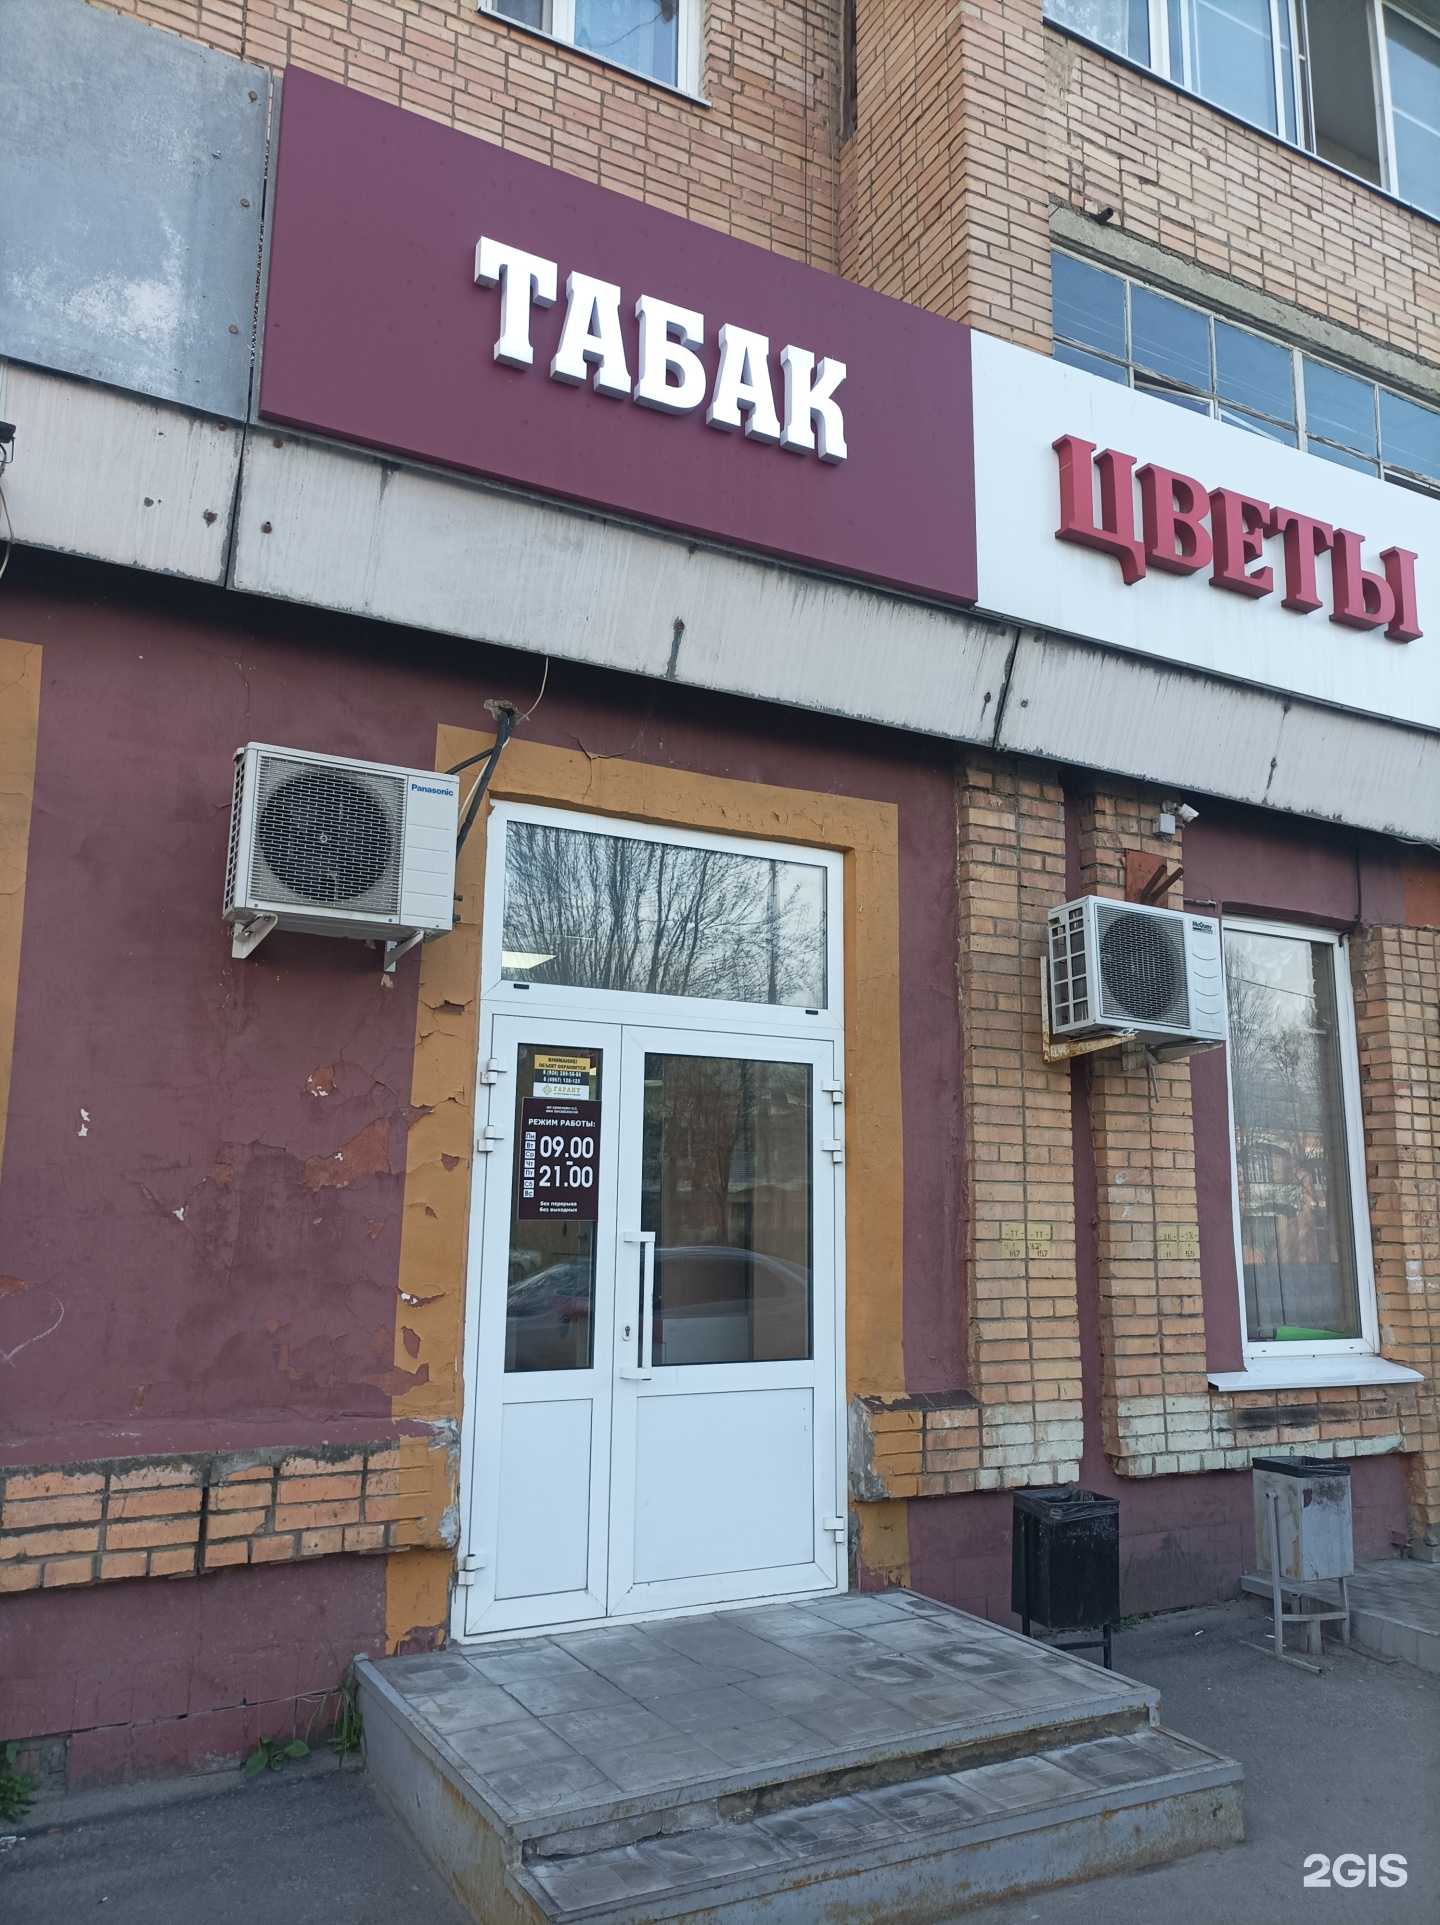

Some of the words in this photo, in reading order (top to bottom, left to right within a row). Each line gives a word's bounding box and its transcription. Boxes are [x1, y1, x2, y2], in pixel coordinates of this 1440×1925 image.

[474, 235, 848, 466] ТАБАК
[1052, 434, 1423, 643] ЦВЕТЫ
[411, 783, 454, 797] Panasonic
[528, 1118, 558, 1126] РЕЖИМ
[560, 1119, 596, 1128] РАБОТЫ:
[540, 1135, 594, 1159] 09.00
[539, 1165, 593, 1188] 21.00
